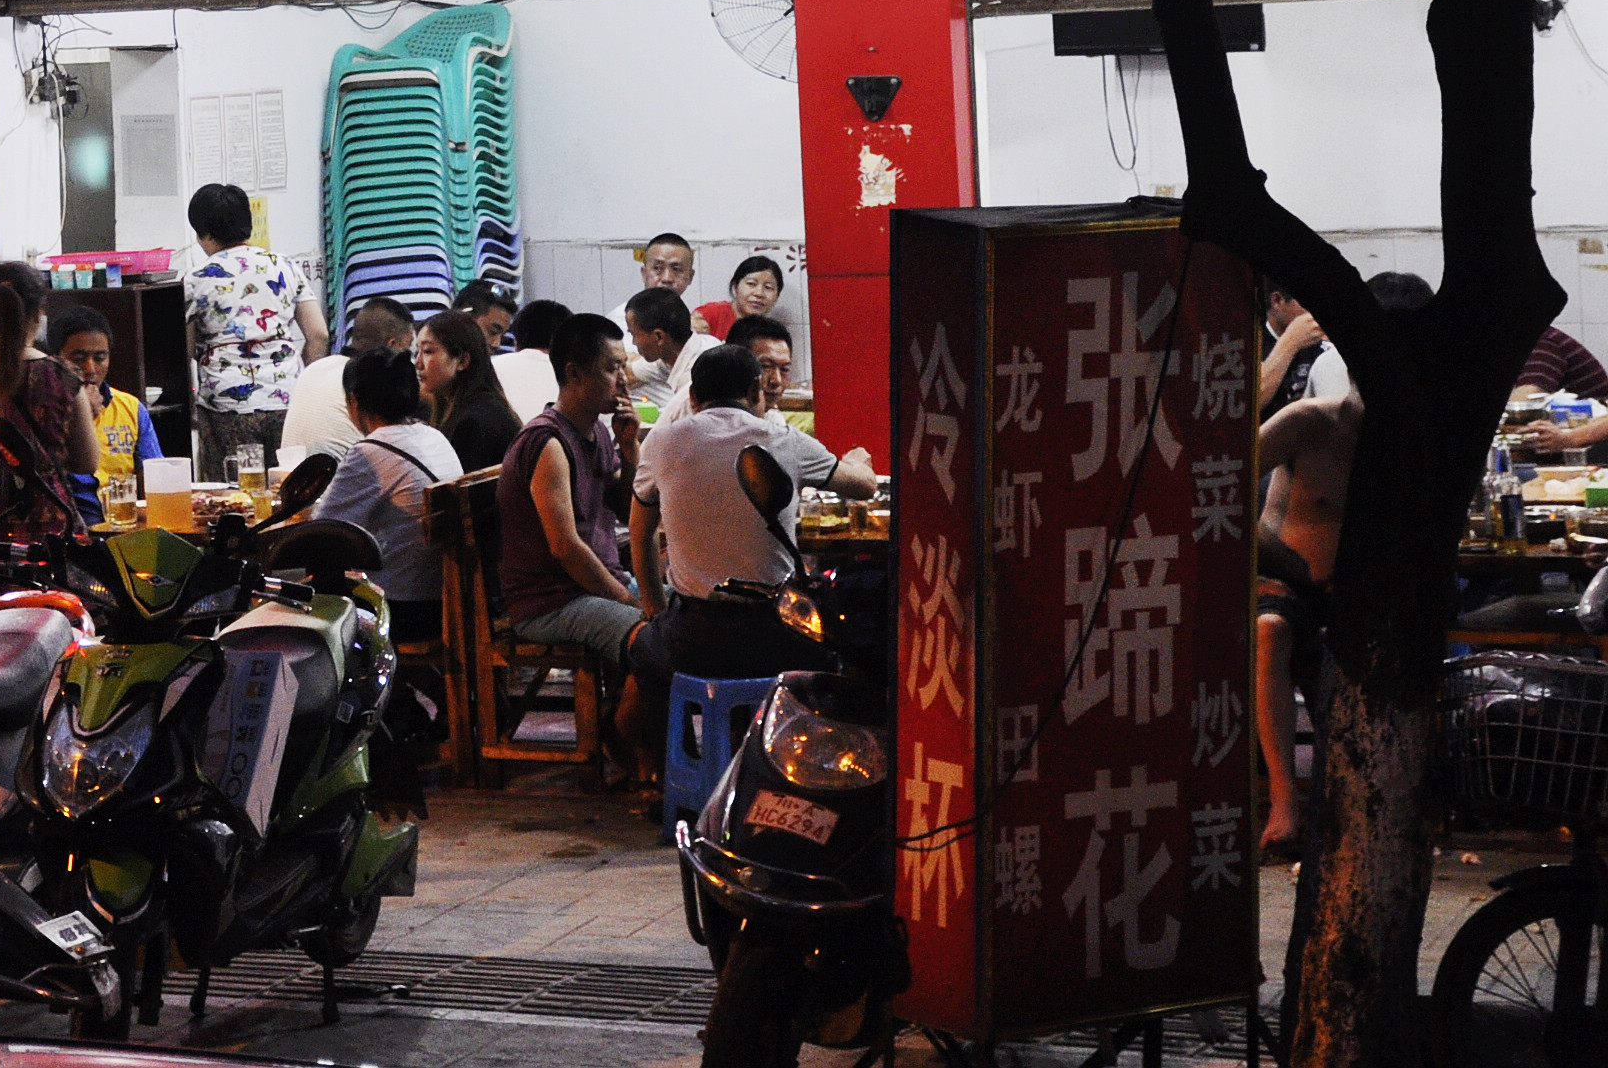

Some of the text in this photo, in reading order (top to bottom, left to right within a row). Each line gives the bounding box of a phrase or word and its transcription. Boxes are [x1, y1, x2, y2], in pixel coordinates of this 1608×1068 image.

[906, 321, 967, 929] 冷淡杯
[994, 344, 1043, 916] 龙虾 田螺
[1060, 270, 1184, 978] 张蹄花
[1192, 332, 1245, 891] 烧菜 炒菜
